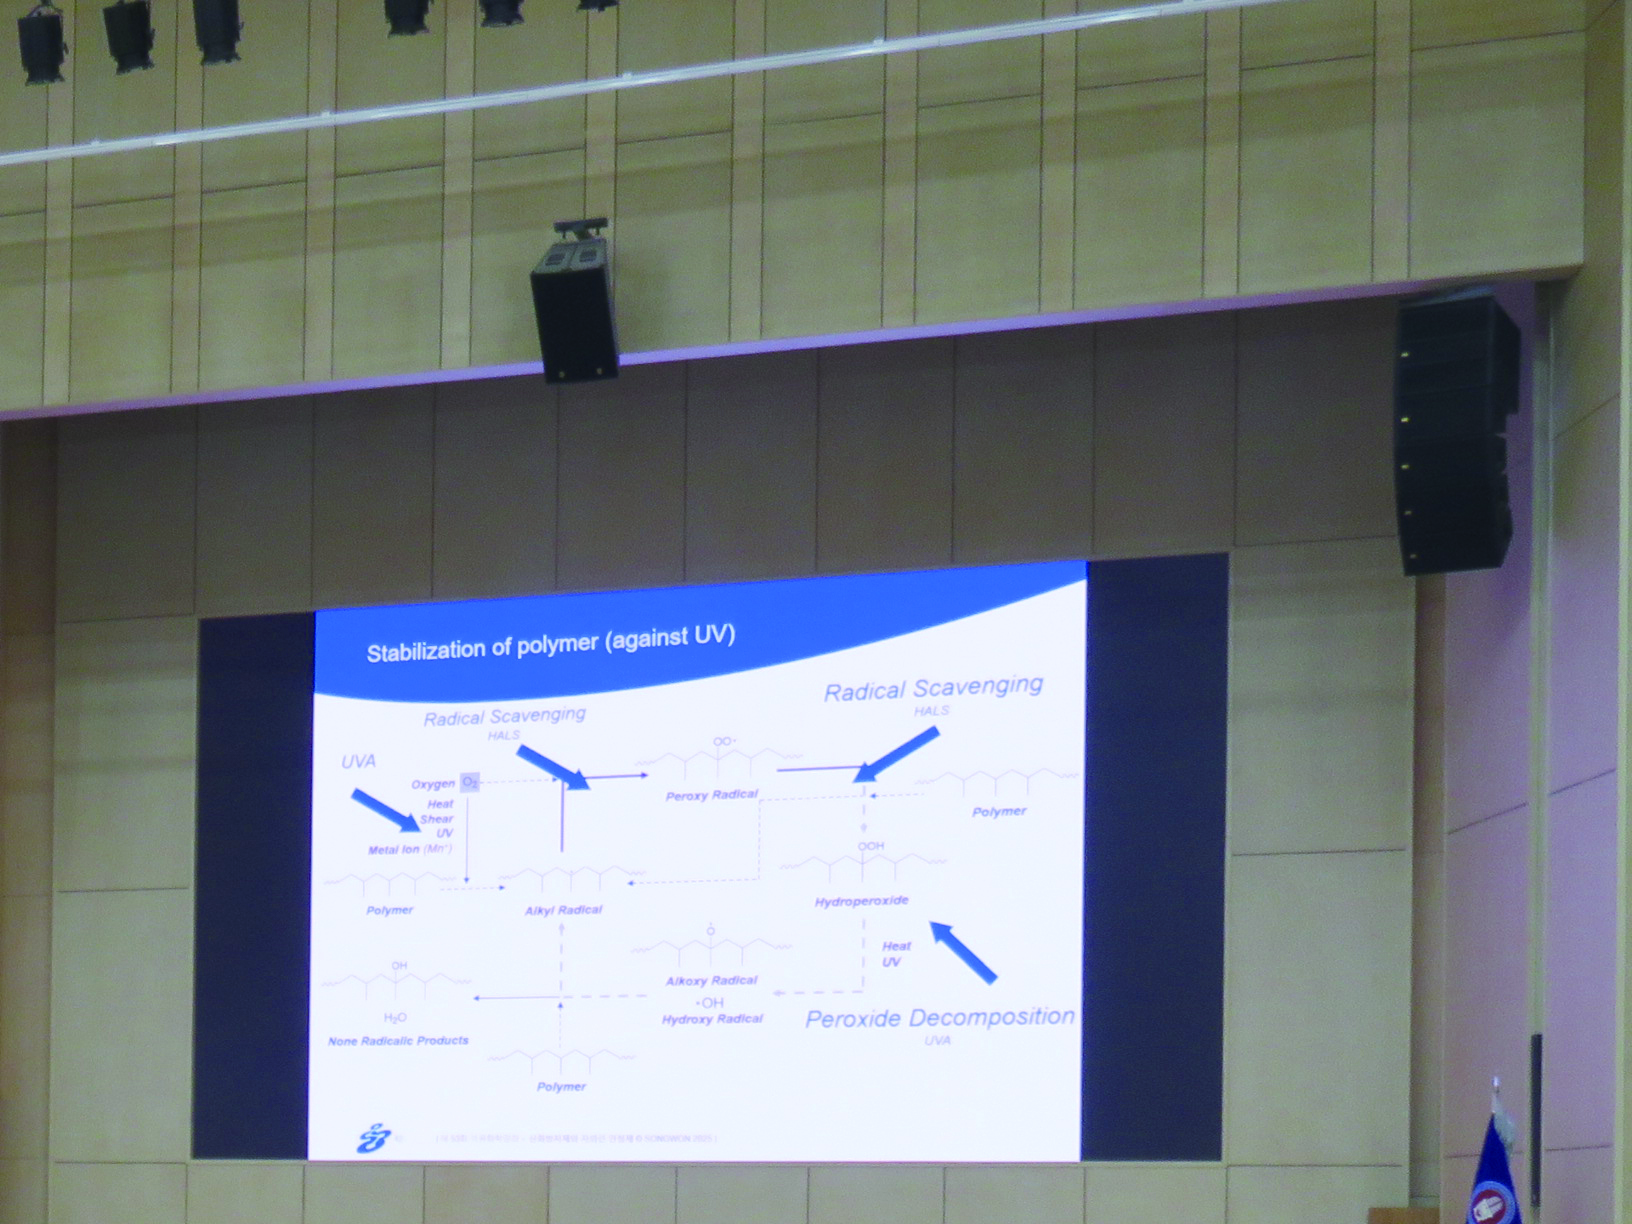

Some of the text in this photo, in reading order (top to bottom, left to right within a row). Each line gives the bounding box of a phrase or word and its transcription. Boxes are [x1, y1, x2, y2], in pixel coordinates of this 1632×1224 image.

[366, 623, 736, 663] Stabilization of polymer (against UV)
[824, 674, 1044, 702] Radical Scavenging
[424, 705, 587, 727] Radical Scavenging
[914, 704, 950, 717] HALS
[487, 729, 521, 741] HALS
[341, 753, 376, 769] UVA
[411, 779, 455, 792] Oxygen
[665, 788, 759, 803] Peroxy Radical
[427, 799, 454, 810] Heat
[972, 805, 1027, 819] Polymer
[420, 814, 454, 825] Shear
[436, 828, 453, 838] UV
[368, 844, 398, 856] Metal
[401, 844, 420, 855] Ion
[858, 841, 885, 851] OOH
[814, 895, 909, 909] Hydroperoxide
[366, 905, 414, 918] Polymer
[524, 904, 603, 918] Alkyl Radical
[882, 940, 912, 952] Heat
[391, 960, 408, 970] OH
[882, 956, 902, 967] UV
[665, 975, 758, 988] Alkoxy Radical
[661, 1013, 764, 1028] Hydroxy Radical
[805, 1005, 1075, 1030] Peroxide Decomposition
[328, 1035, 469, 1047] None Radicalic Products
[924, 1034, 952, 1046] UVA
[536, 1081, 587, 1094] Polymer
